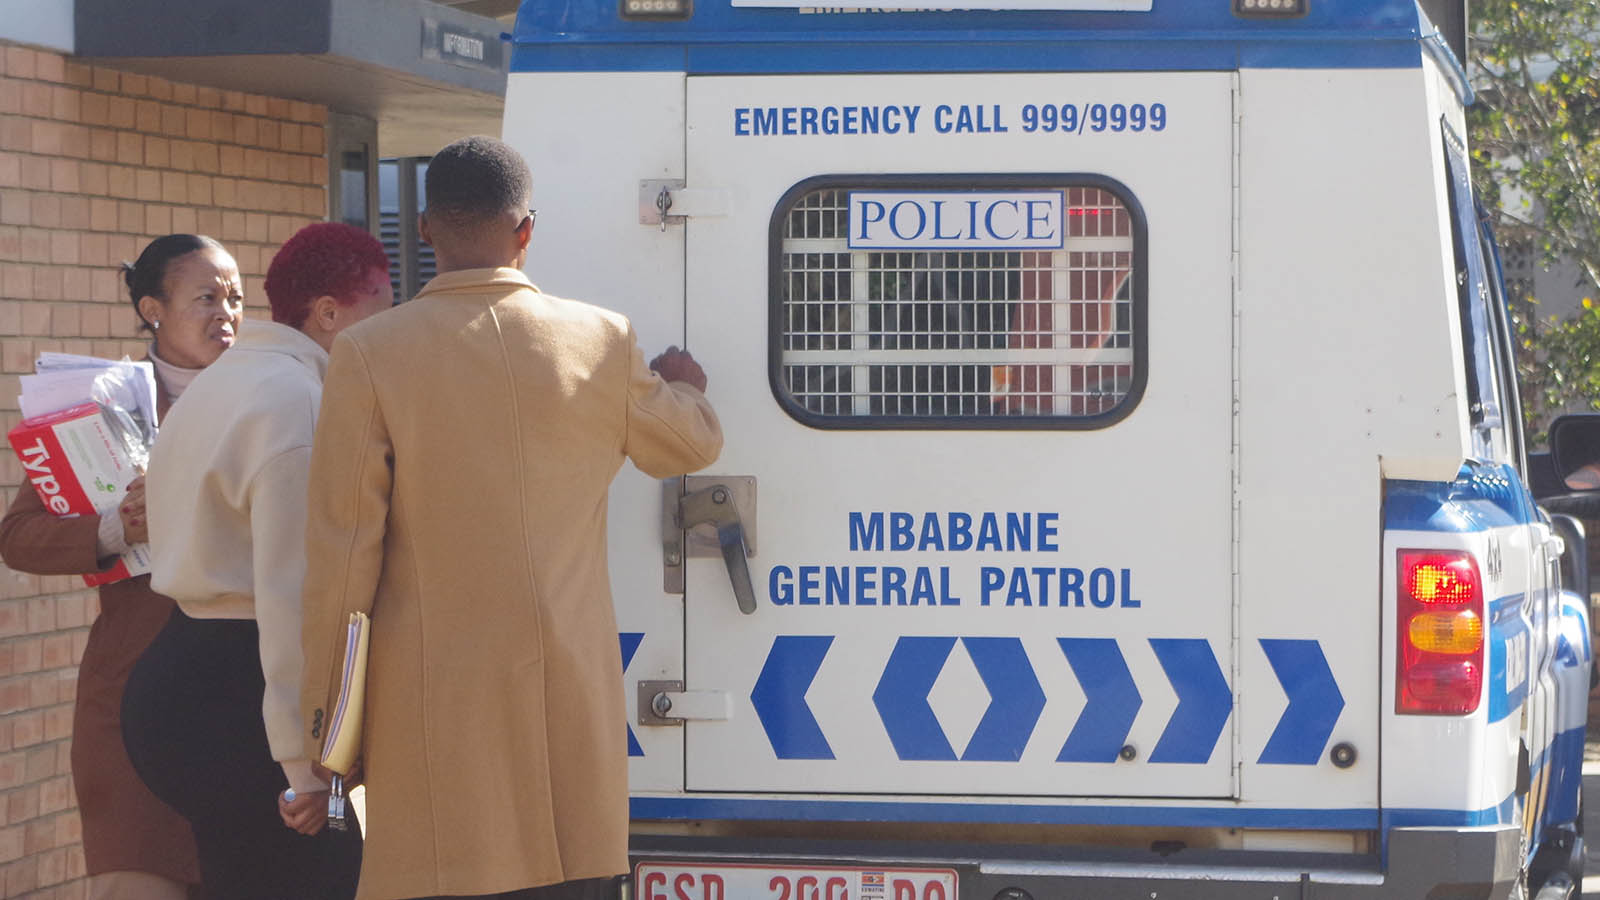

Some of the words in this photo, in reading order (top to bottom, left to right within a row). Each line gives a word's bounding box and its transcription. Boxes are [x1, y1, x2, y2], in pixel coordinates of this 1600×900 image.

[735, 105, 921, 136] EMERGENCY
[934, 104, 1008, 134] CALL
[1021, 103, 1167, 135] 999/9999
[856, 200, 1055, 241] POLICE
[849, 512, 1059, 552] MBABANE
[769, 565, 960, 606] GENERAL
[980, 567, 1141, 608] PATROL
